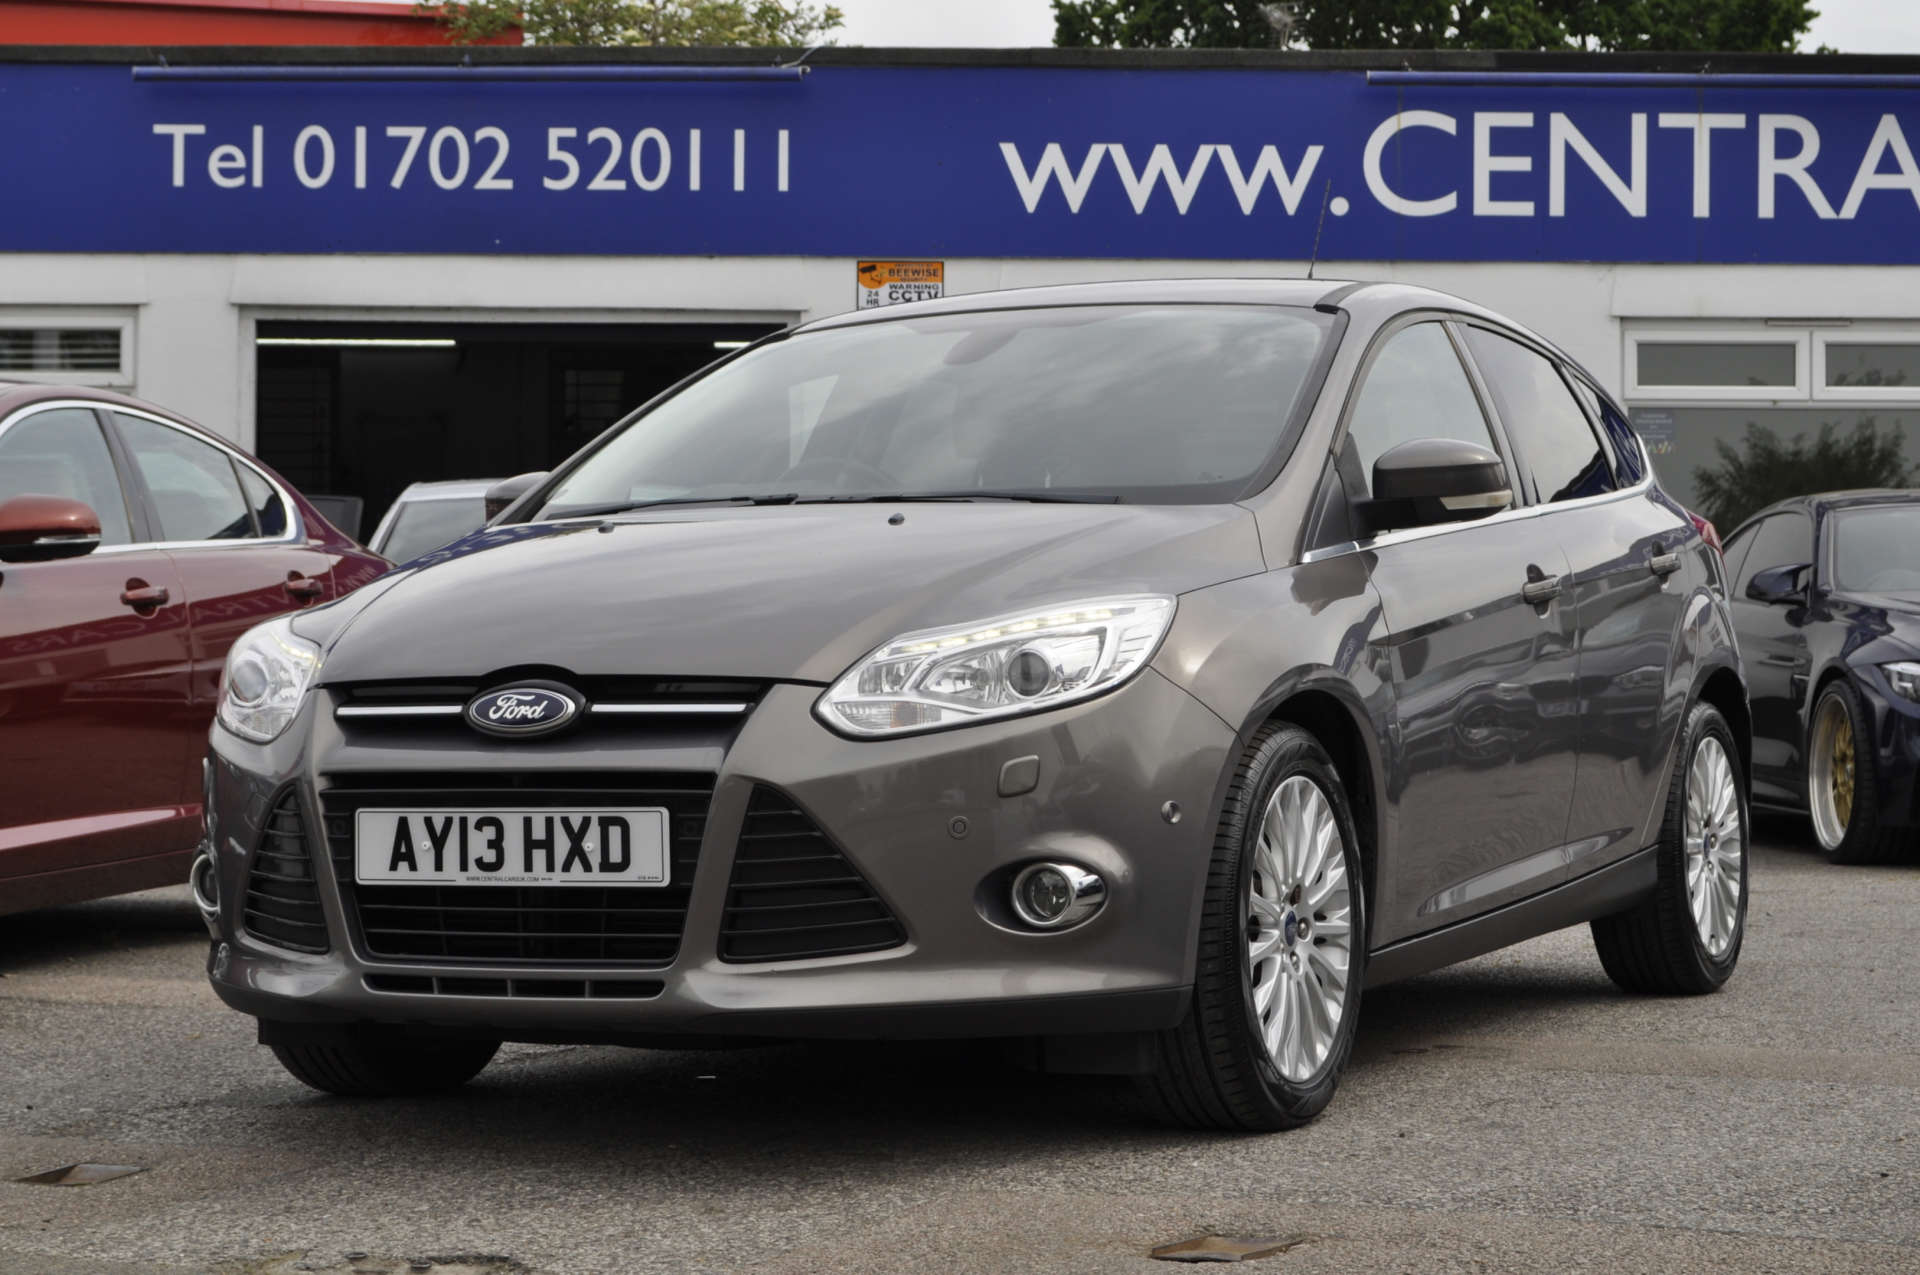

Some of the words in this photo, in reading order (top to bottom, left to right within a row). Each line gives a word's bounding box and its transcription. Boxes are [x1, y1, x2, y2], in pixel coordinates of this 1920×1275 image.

[153, 125, 263, 188] Tel
[294, 126, 514, 191] 01702
[544, 127, 789, 192] 520111
[888, 268, 939, 277] BEEWISE
[888, 290, 938, 302] CCTV
[488, 694, 549, 720] Ford
[389, 816, 505, 873] AY13
[523, 816, 632, 874] HXD
